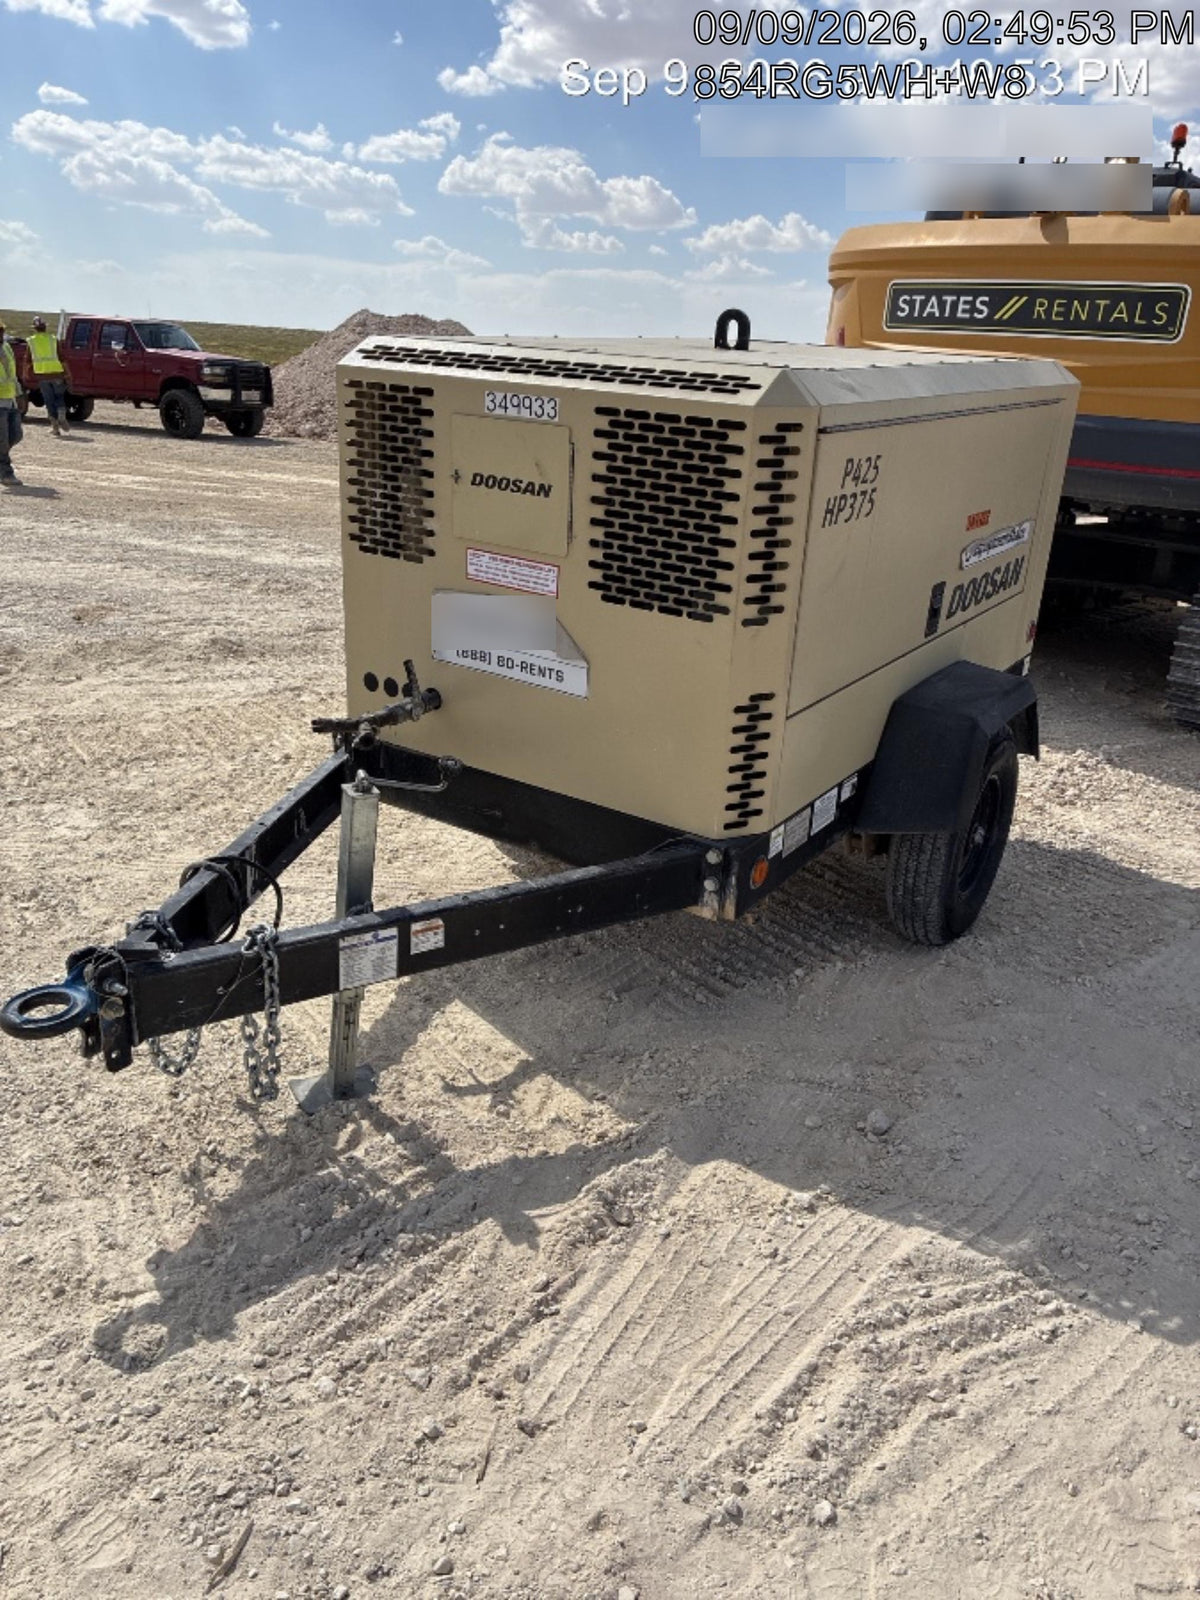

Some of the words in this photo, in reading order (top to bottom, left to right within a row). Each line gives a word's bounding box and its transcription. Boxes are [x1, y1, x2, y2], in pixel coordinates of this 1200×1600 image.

[897, 295, 990, 319] STATES
[1032, 297, 1169, 325] RENTALS
[485, 392, 559, 420] 349933
[469, 471, 554, 498] DOOSAN
[840, 454, 882, 489] P425
[821, 487, 878, 528] HP375
[946, 556, 1025, 621] DOOSAN
